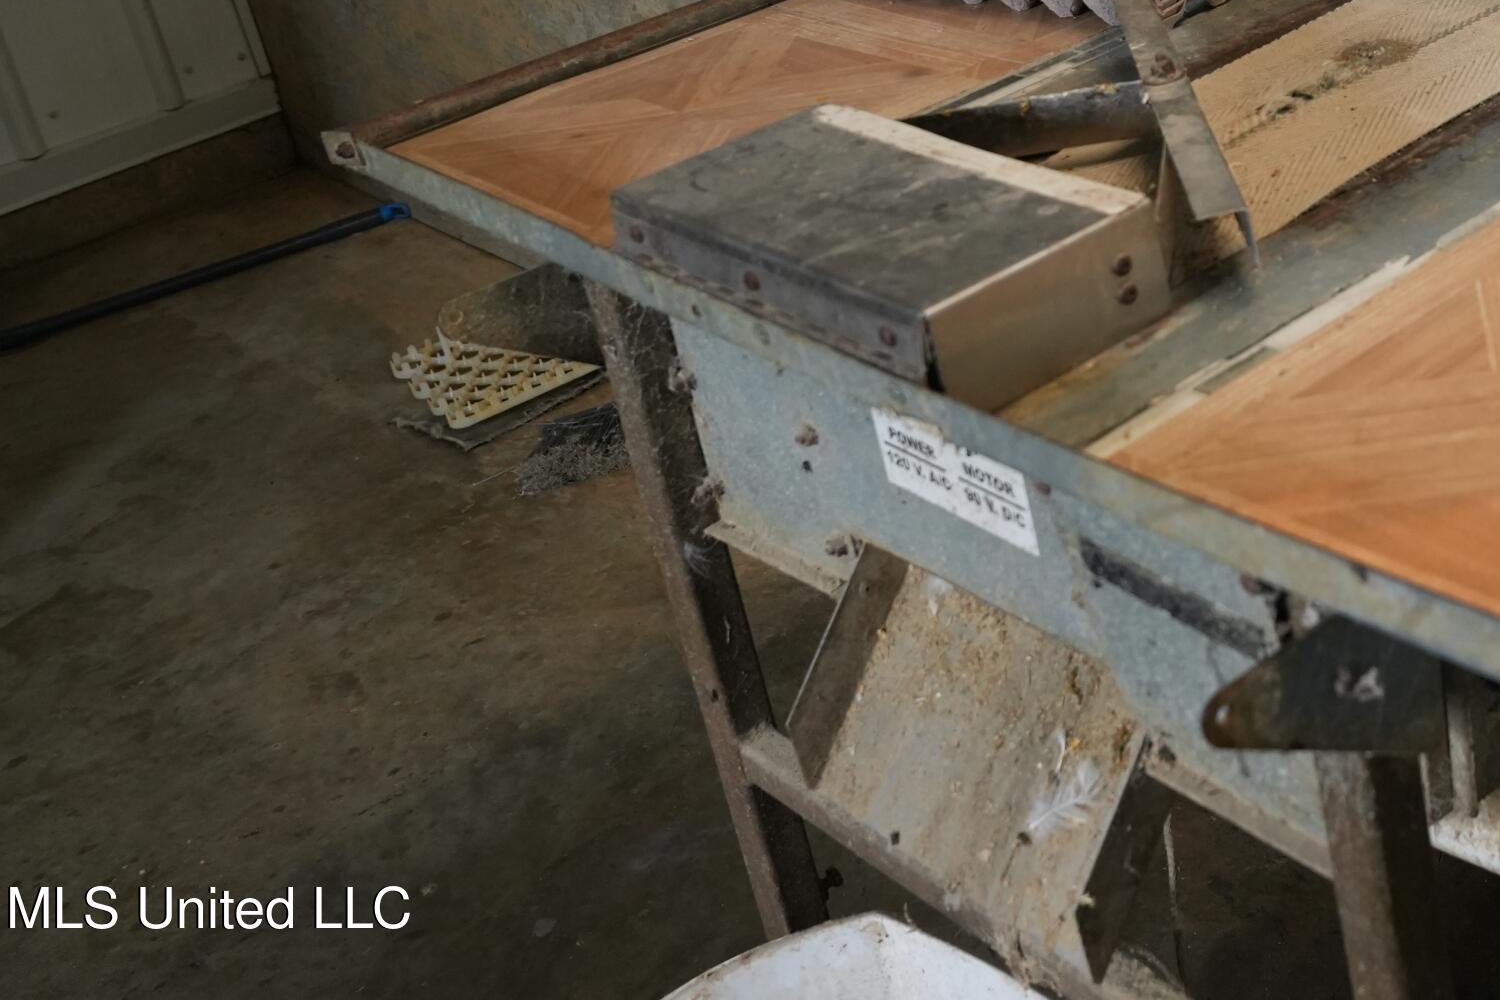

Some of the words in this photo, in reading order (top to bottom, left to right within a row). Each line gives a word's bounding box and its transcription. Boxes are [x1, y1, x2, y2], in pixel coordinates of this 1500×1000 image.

[887, 426, 937, 459] POWER
[887, 450, 911, 472] 120
[962, 462, 1016, 498] MOTOR
